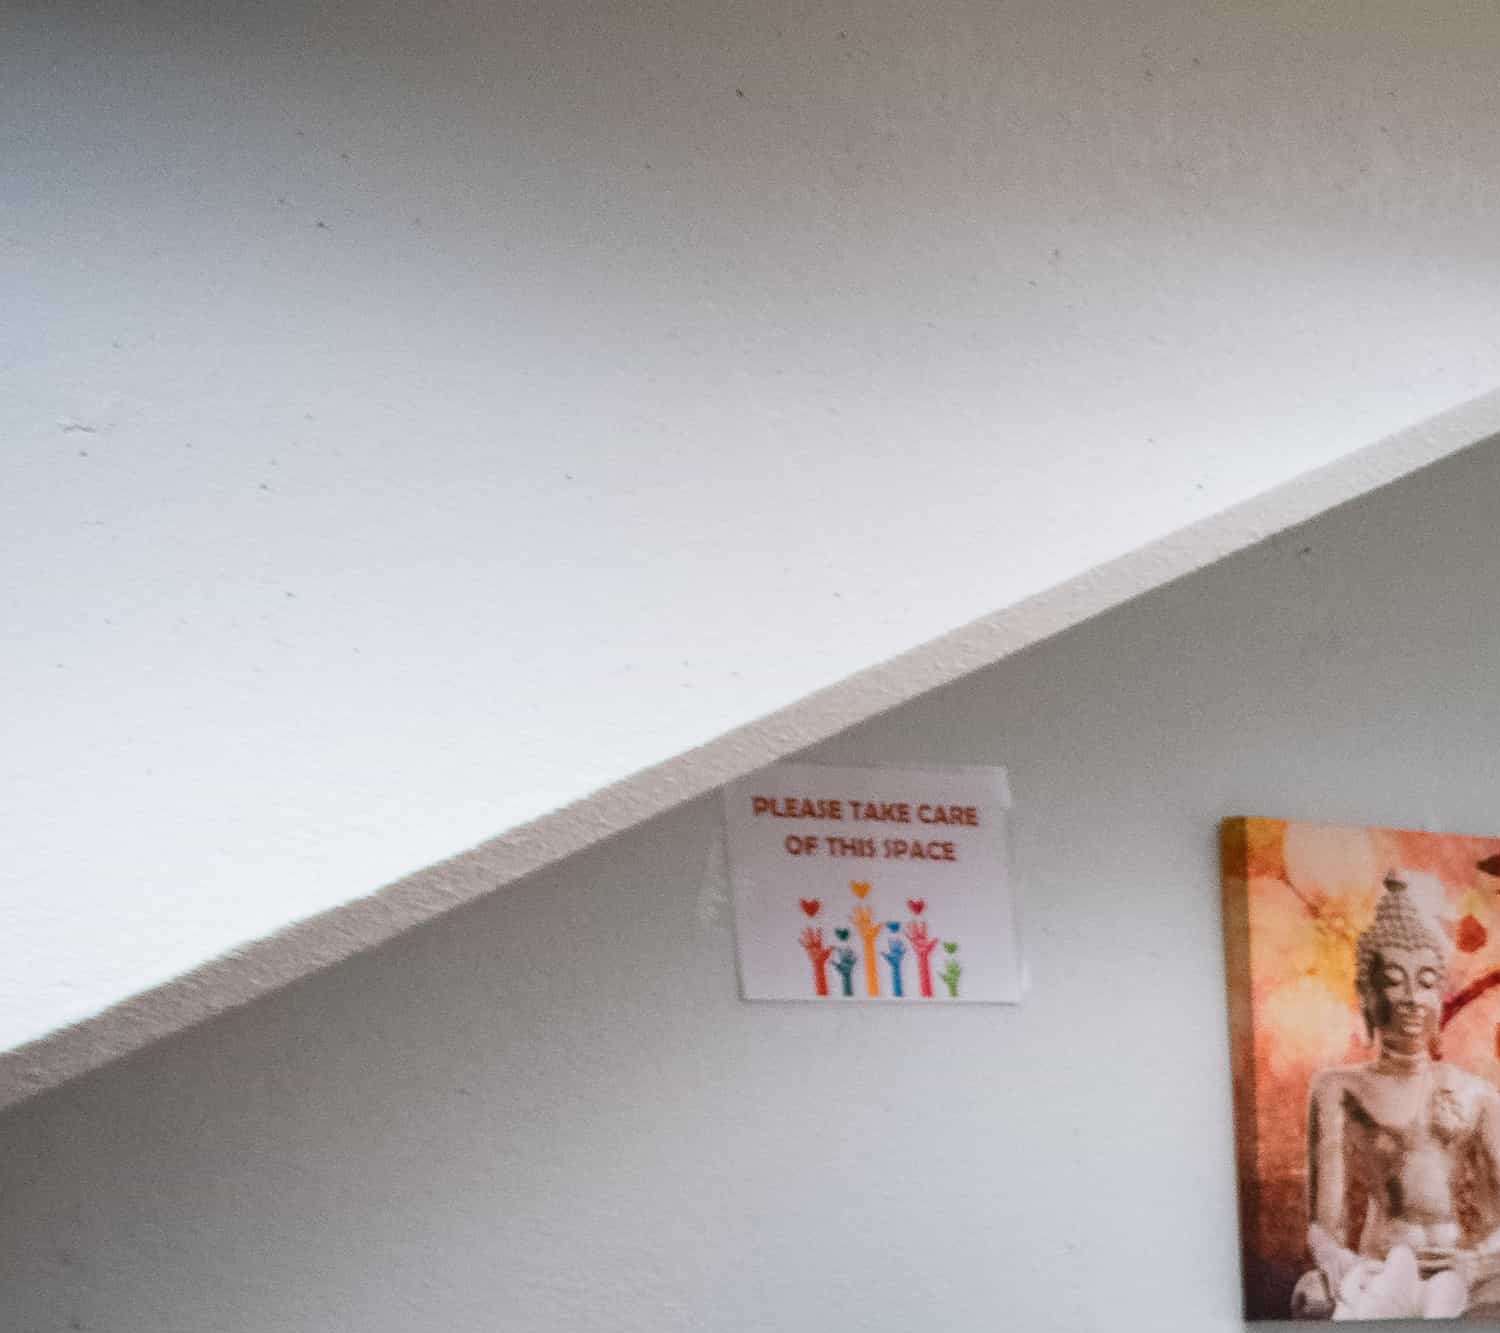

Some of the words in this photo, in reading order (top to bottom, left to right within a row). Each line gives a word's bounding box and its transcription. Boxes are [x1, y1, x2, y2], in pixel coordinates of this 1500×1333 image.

[752, 796, 843, 820] PLEASE
[848, 800, 912, 824] TAKE
[916, 804, 980, 827] CARE
[784, 833, 818, 856] OF
[825, 836, 877, 859] THIS
[883, 839, 958, 862] SPACE
